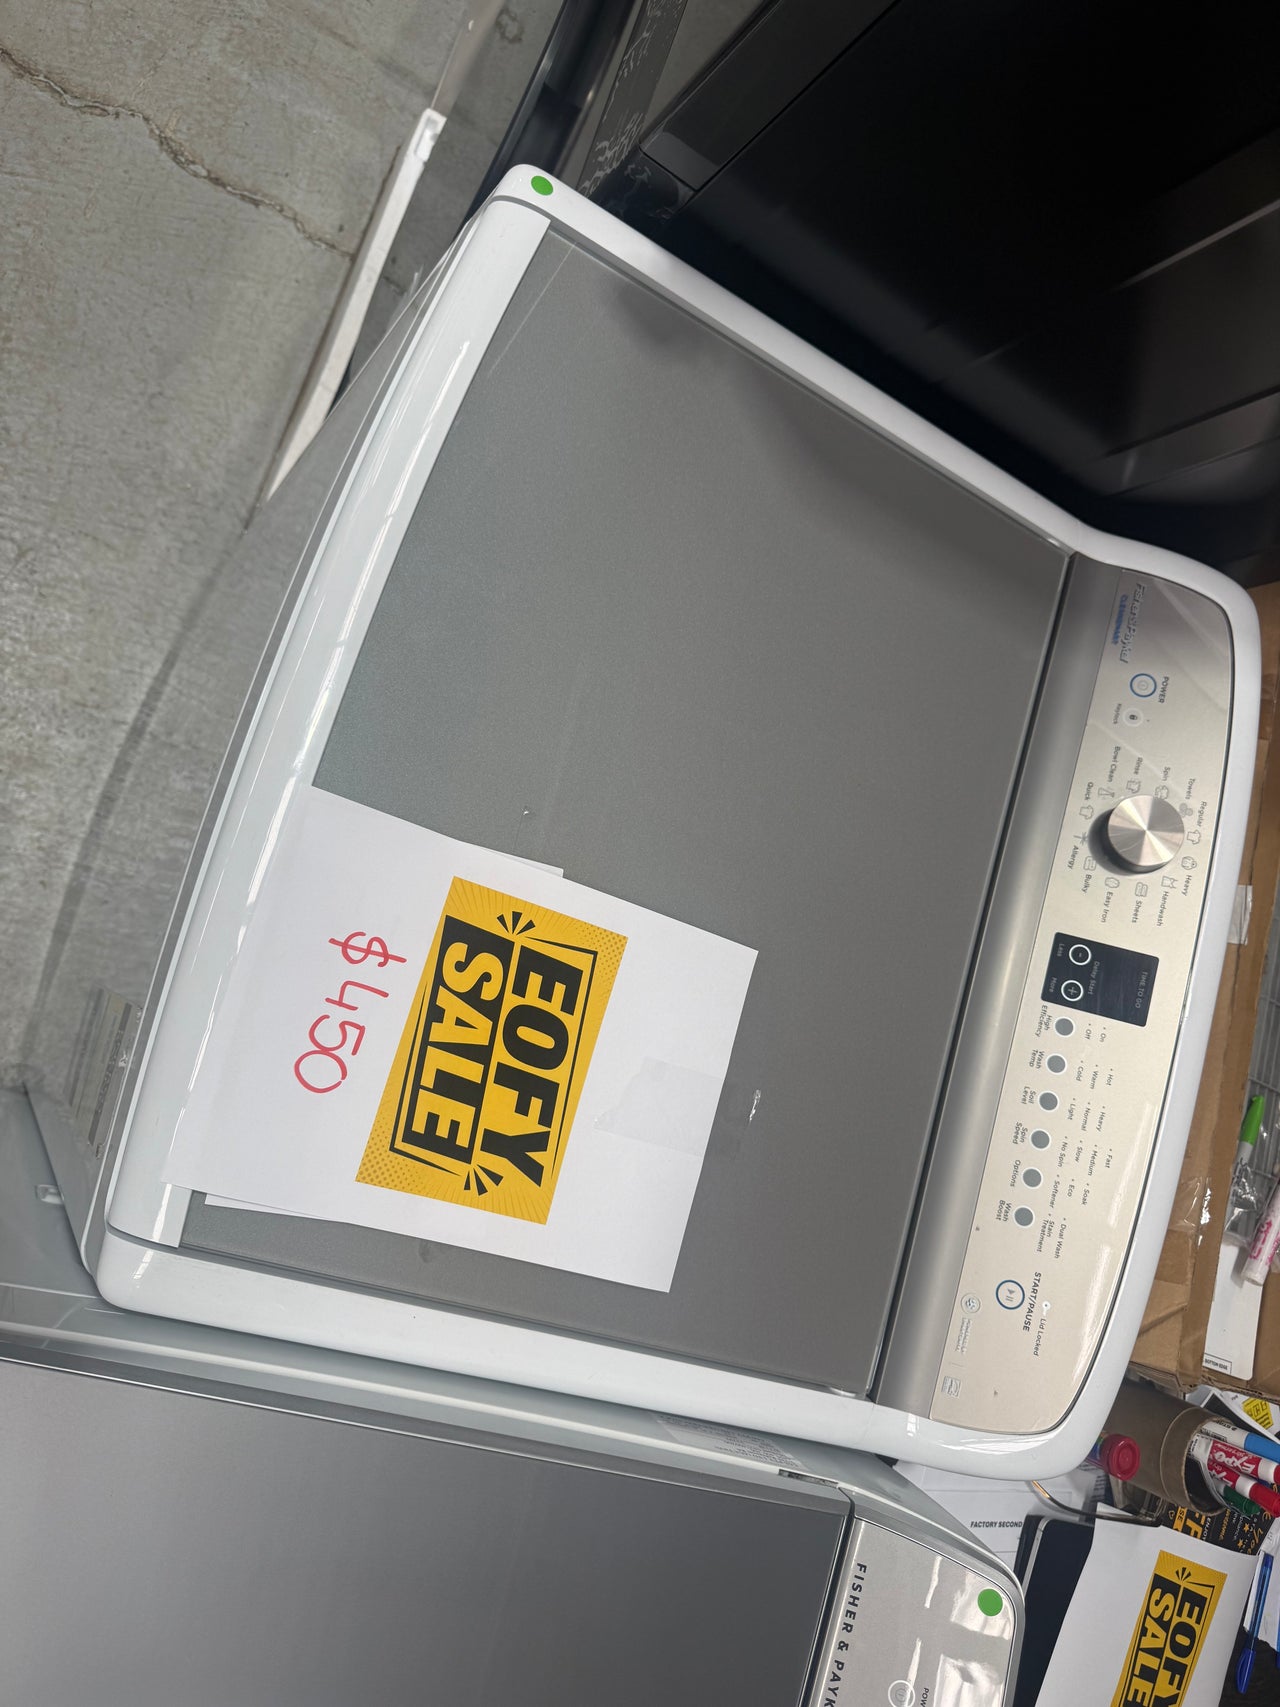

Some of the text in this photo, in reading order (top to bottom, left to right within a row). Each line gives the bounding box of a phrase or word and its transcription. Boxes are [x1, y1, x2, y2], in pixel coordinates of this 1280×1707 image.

[1158, 676, 1169, 704] POWER
[1106, 746, 1121, 783] Bowl Clean
[1133, 757, 1143, 775] Rinse
[1161, 766, 1171, 782] Spin
[1084, 782, 1094, 801] Quick
[1185, 778, 1196, 800] Towels
[1196, 801, 1207, 828] Regular
[1067, 845, 1080, 870] Allergy
[1081, 874, 1092, 894] Bulky
[1181, 874, 1193, 896] Heavy
[1101, 891, 1113, 923] Easy Iron
[1131, 900, 1143, 924] Sheets
[1156, 891, 1170, 927] Handwash
[1056, 944, 1065, 957] Less
[1048, 977, 1058, 993] More
[1087, 961, 1100, 995] Delay Start
[1135, 971, 1148, 1009] TIME TO GO
[1034, 1005, 1048, 1038] Efficiency
[1043, 1015, 1053, 1031] High
[411, 941, 504, 1149] SALE
[1084, 1029, 1092, 1040] Off
[1099, 1033, 1107, 1043] On
[480, 944, 584, 1187] EOFY
[1028, 1049, 1038, 1068] Temp
[1035, 1051, 1045, 1070] Wash
[1075, 1066, 1084, 1082] Cold
[1089, 1071, 1099, 1090] Warm
[1106, 1074, 1114, 1086] Hot
[1021, 1086, 1031, 1105] Level
[1028, 1090, 1037, 1104] Soil
[1067, 1103, 1076, 1121] Light
[1080, 1108, 1091, 1132] Normal
[1095, 1111, 1106, 1132] Heavy
[1012, 1122, 1022, 1145] Speed
[1018, 1127, 1028, 1143] Spin
[1057, 1142, 1068, 1168] No Spin
[1074, 1146, 1083, 1163] Slow
[1087, 1150, 1098, 1176] Medium
[1104, 1154, 1113, 1168] Fast
[1010, 1159, 1021, 1188] Options
[1048, 1180, 1060, 1209] Softener
[1067, 1184, 1075, 1198] Eco
[1081, 1189, 1090, 1206] Soak
[995, 1199, 1005, 1221] Boost
[1002, 1202, 1012, 1222] Wash
[1036, 1219, 1049, 1253] Treatment
[1046, 1220, 1055, 1238] Stain
[1053, 1224, 1067, 1259] Dual Wash
[1022, 1271, 1042, 1332] START/PAUSE
[1033, 1318, 1047, 1357] Lid Locked
[841, 1562, 867, 1634] FISHER
[836, 1640, 849, 1653] &
[1127, 1587, 1175, 1707] SALE
